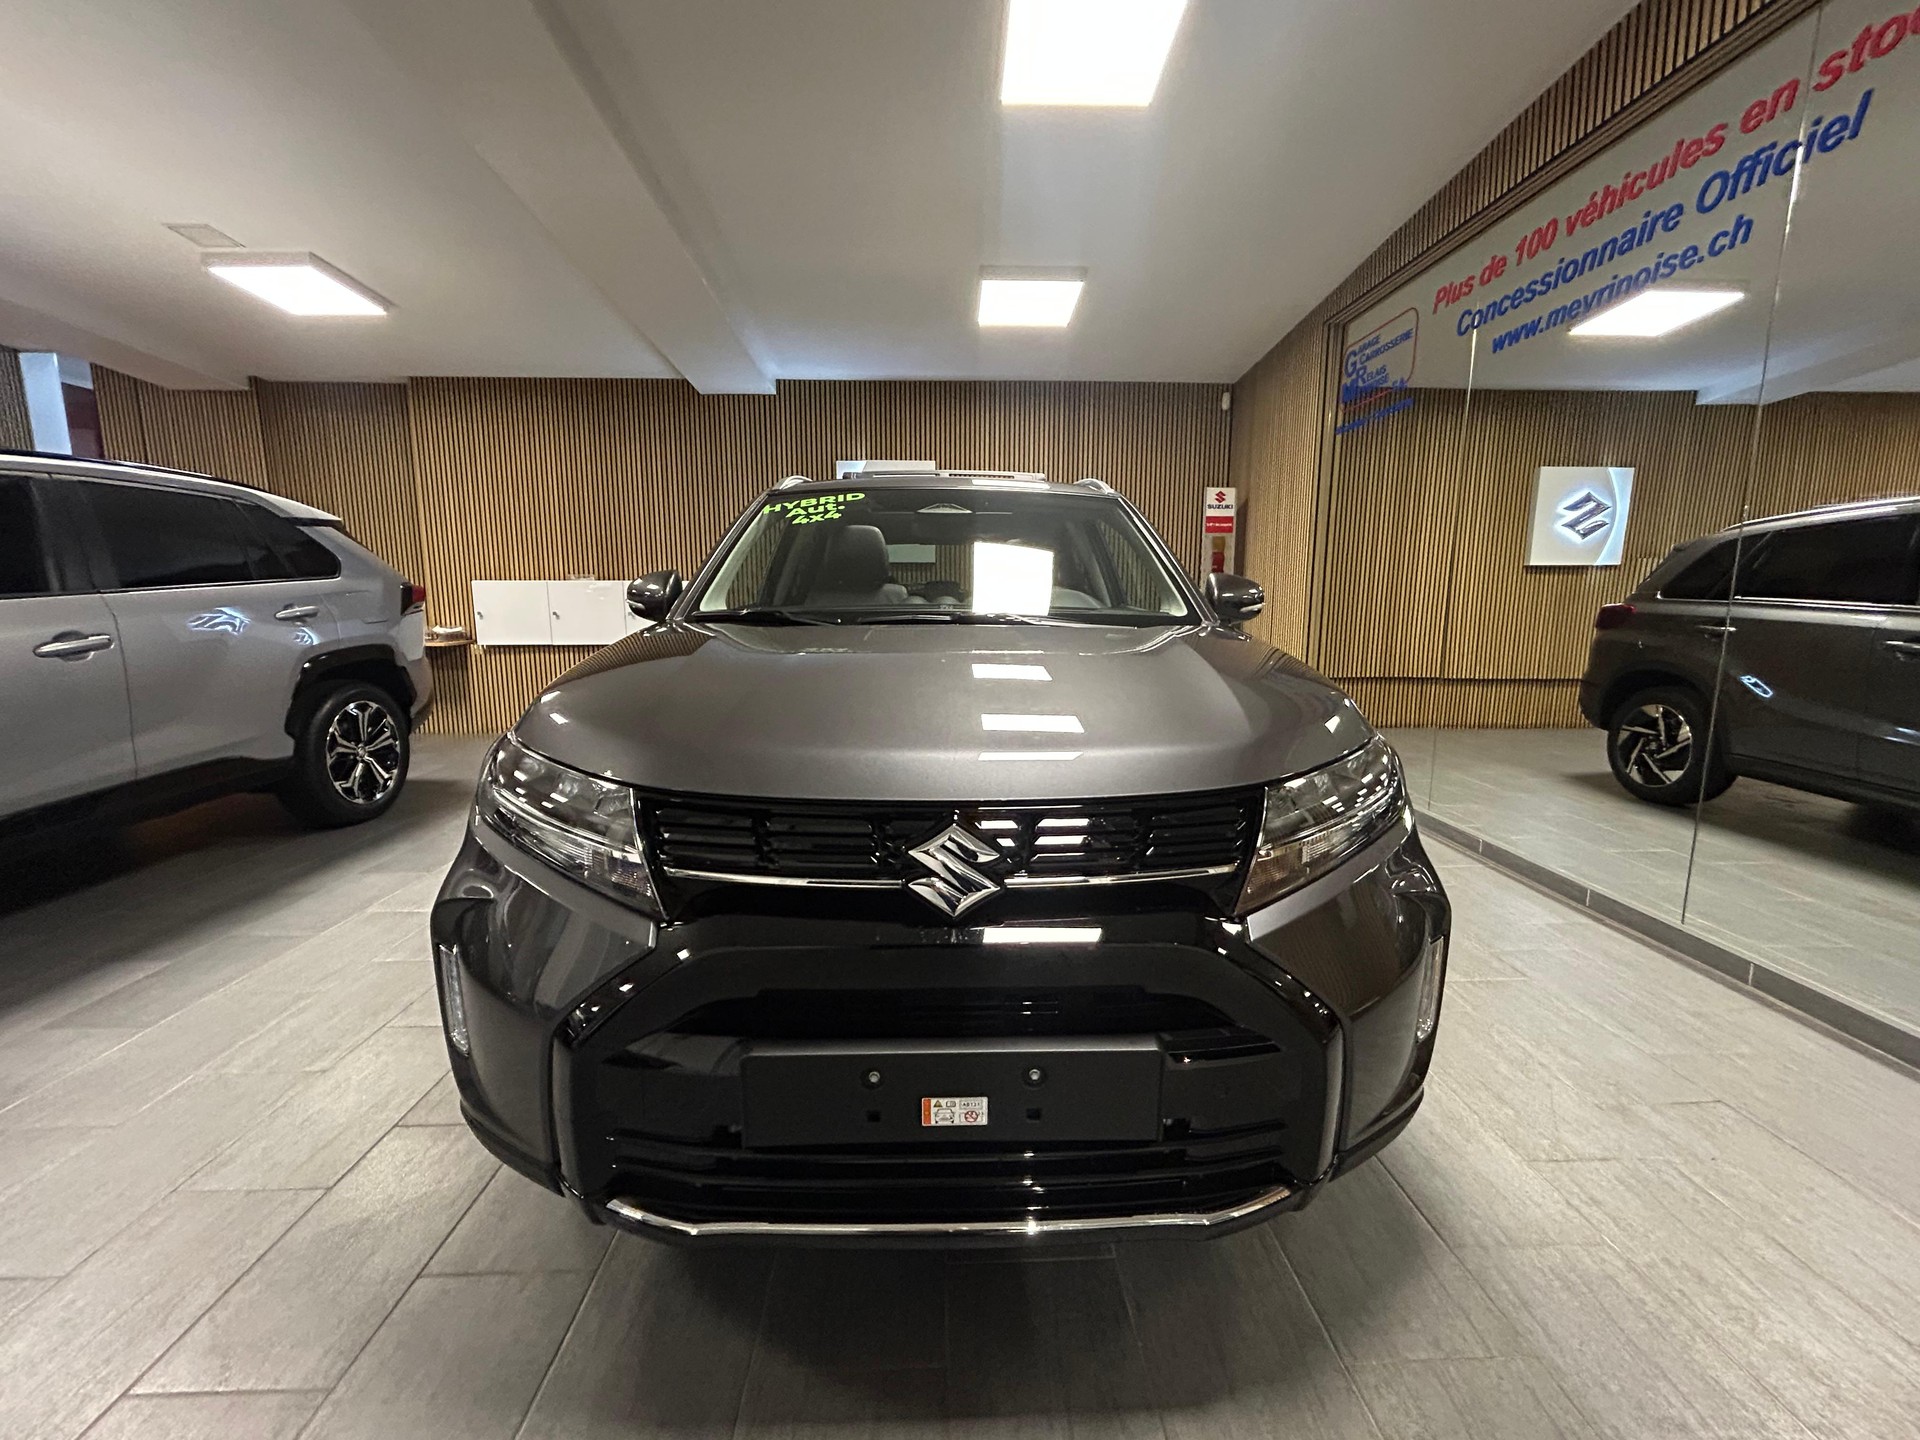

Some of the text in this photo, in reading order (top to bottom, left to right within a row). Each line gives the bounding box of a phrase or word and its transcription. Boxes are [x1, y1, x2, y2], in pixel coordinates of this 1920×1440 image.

[1433, 275, 1475, 314] Plus
[1478, 255, 1508, 287] de
[1515, 217, 1559, 266] 100
[1564, 122, 1728, 237] véhicules
[1739, 77, 1801, 135] en
[1456, 88, 1875, 337] Concessionnaire Officiel
[1492, 213, 1754, 354] www.meyrinoise.ch
[763, 493, 865, 514] HYBRID
[786, 503, 845, 518] Aut.
[792, 511, 842, 525] 4x4
